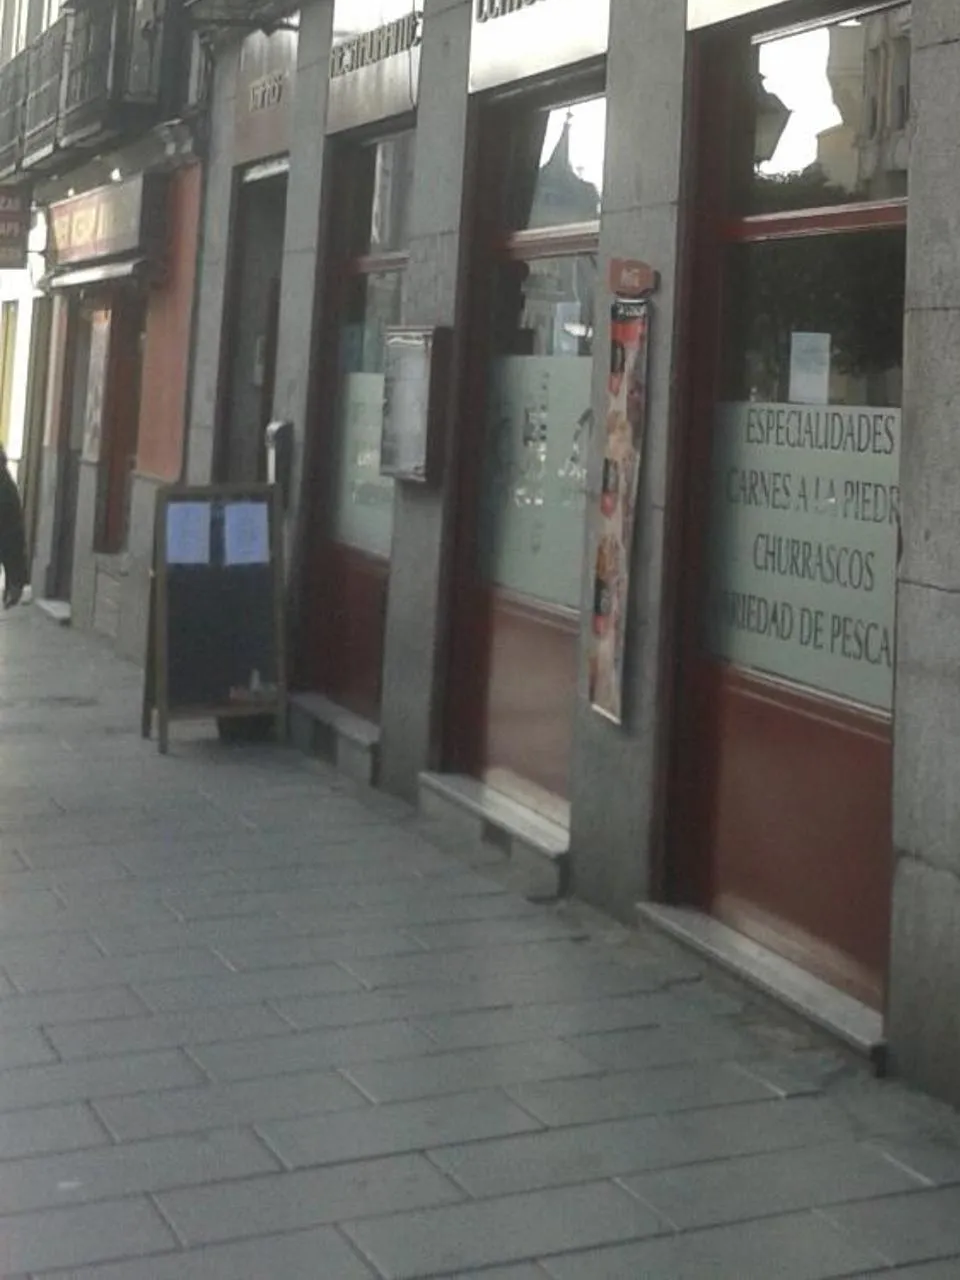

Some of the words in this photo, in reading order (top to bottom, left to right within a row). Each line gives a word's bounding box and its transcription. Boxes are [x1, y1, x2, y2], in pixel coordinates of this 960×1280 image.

[745, 408, 896, 455] ESPECIALIDADES
[726, 466, 792, 510] CARNES
[798, 476, 809, 513] A
[753, 534, 875, 592] CHURRASCOS
[800, 608, 824, 650] DE
